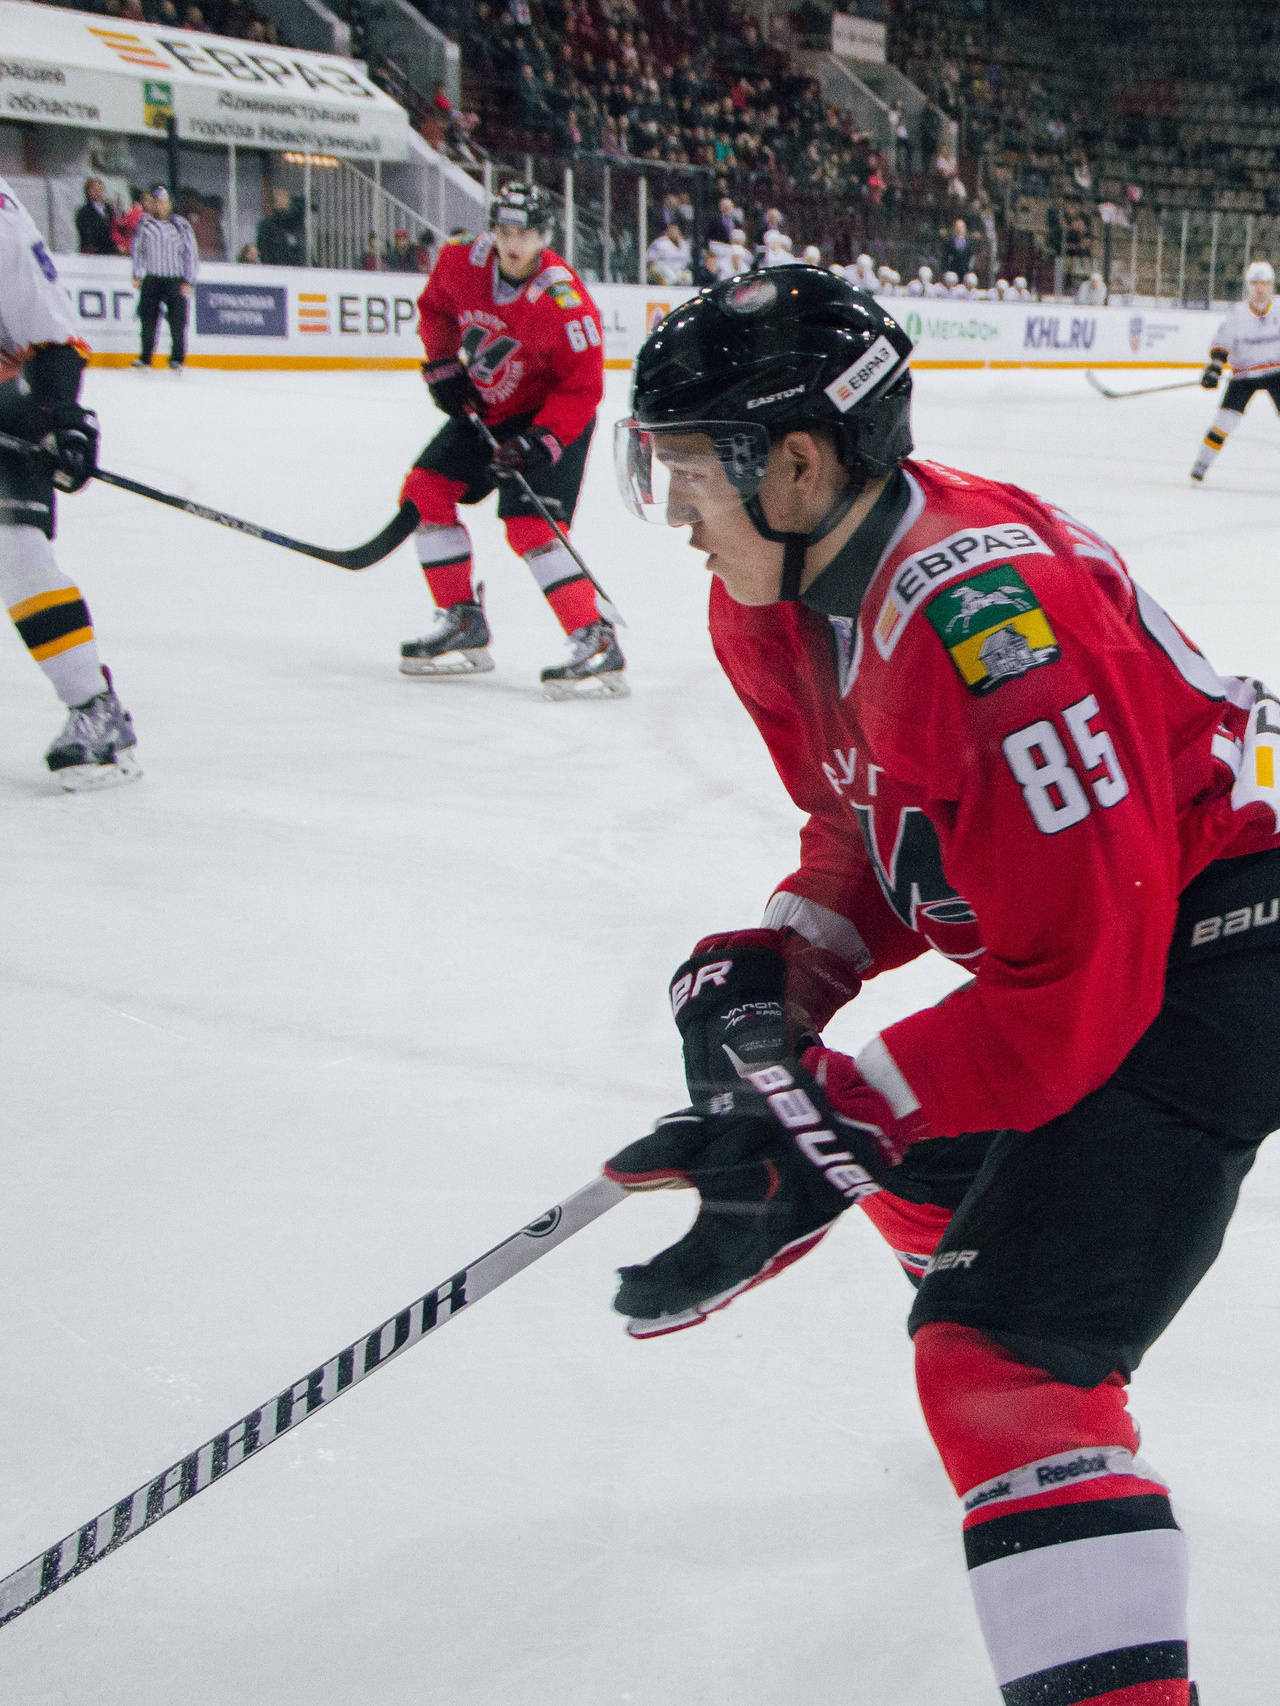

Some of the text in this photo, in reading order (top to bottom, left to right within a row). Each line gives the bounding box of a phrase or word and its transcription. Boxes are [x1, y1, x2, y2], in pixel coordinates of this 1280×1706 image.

[156, 38, 378, 101] ЕВРАЗ
[1023, 315, 1097, 350] KHL.RU
[848, 347, 890, 390] ЕВРАЗ
[896, 528, 1038, 603] ЕВРАЗ
[1001, 694, 1129, 835] 85
[38, 1270, 470, 1602] WARRIOR
[1036, 1453, 1107, 1488] Reebok
